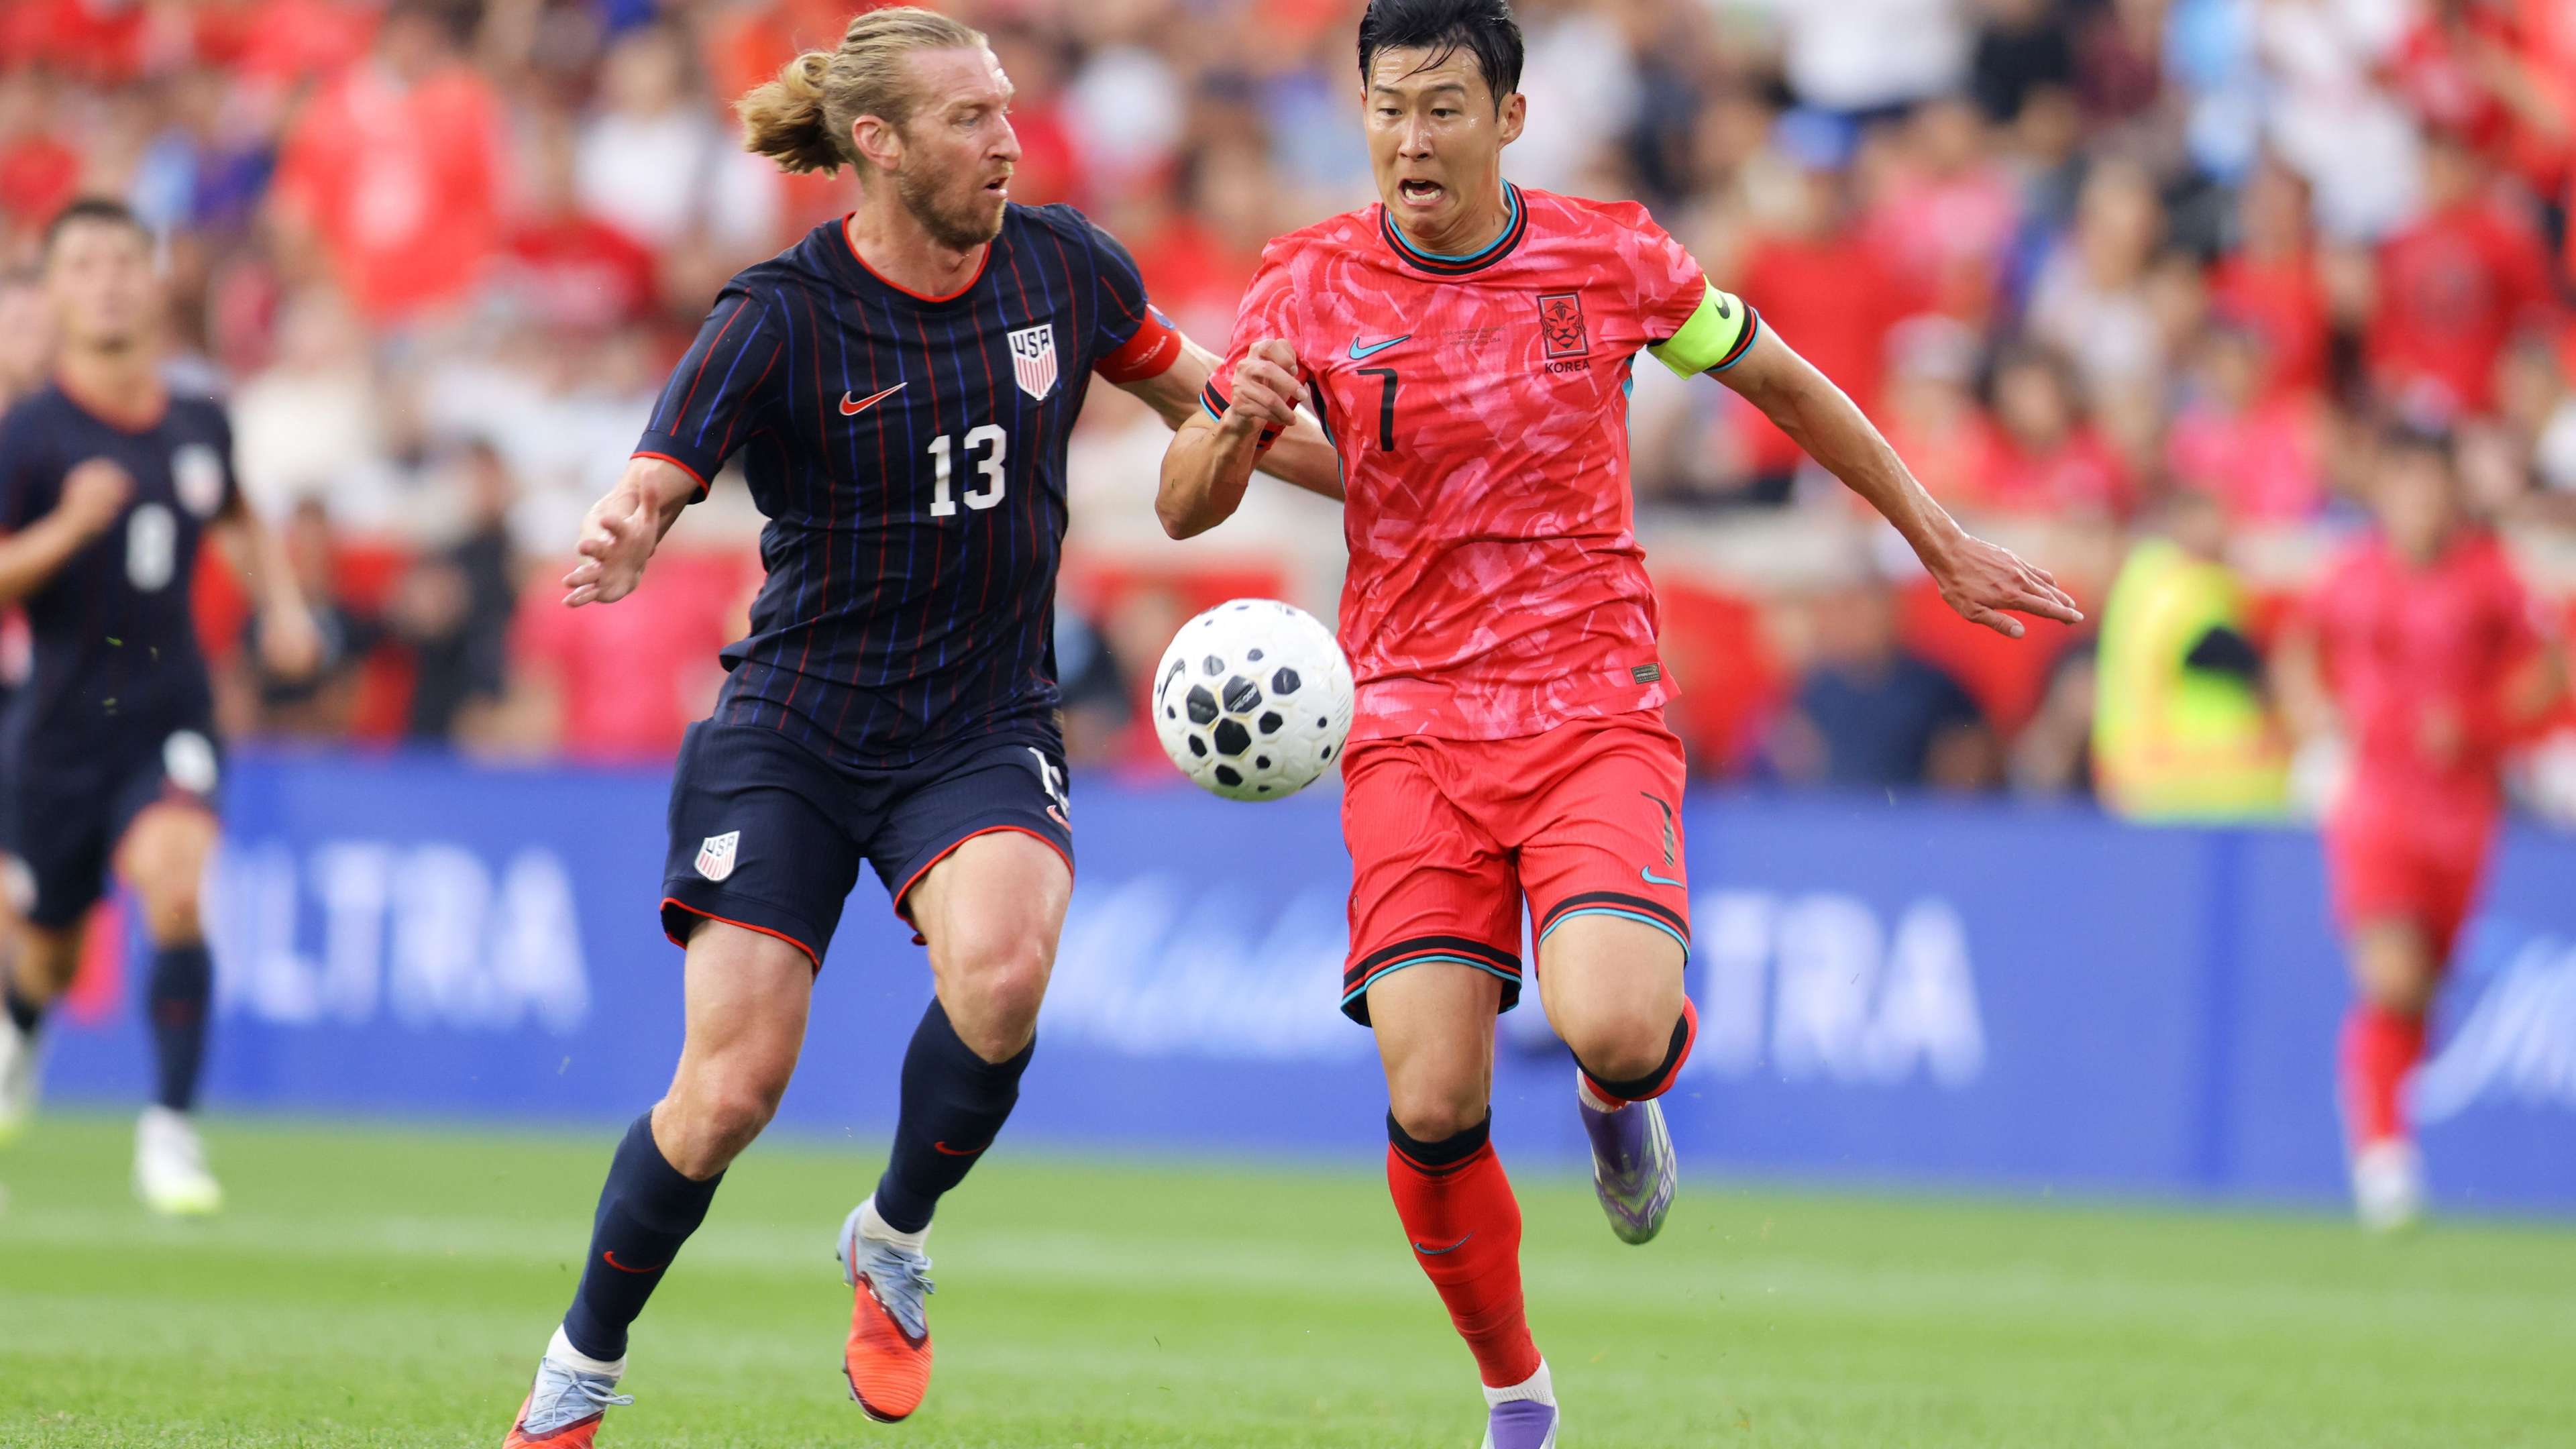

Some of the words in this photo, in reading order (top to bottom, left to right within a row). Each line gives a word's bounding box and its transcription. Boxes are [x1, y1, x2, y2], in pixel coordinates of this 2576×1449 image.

[1012, 328, 1050, 358] USA
[1545, 359, 1591, 374] KOREA
[1356, 368, 1397, 452] 7
[928, 423, 1006, 517] 13
[705, 834, 736, 857] USA
[1687, 889, 1989, 1088] TRA
